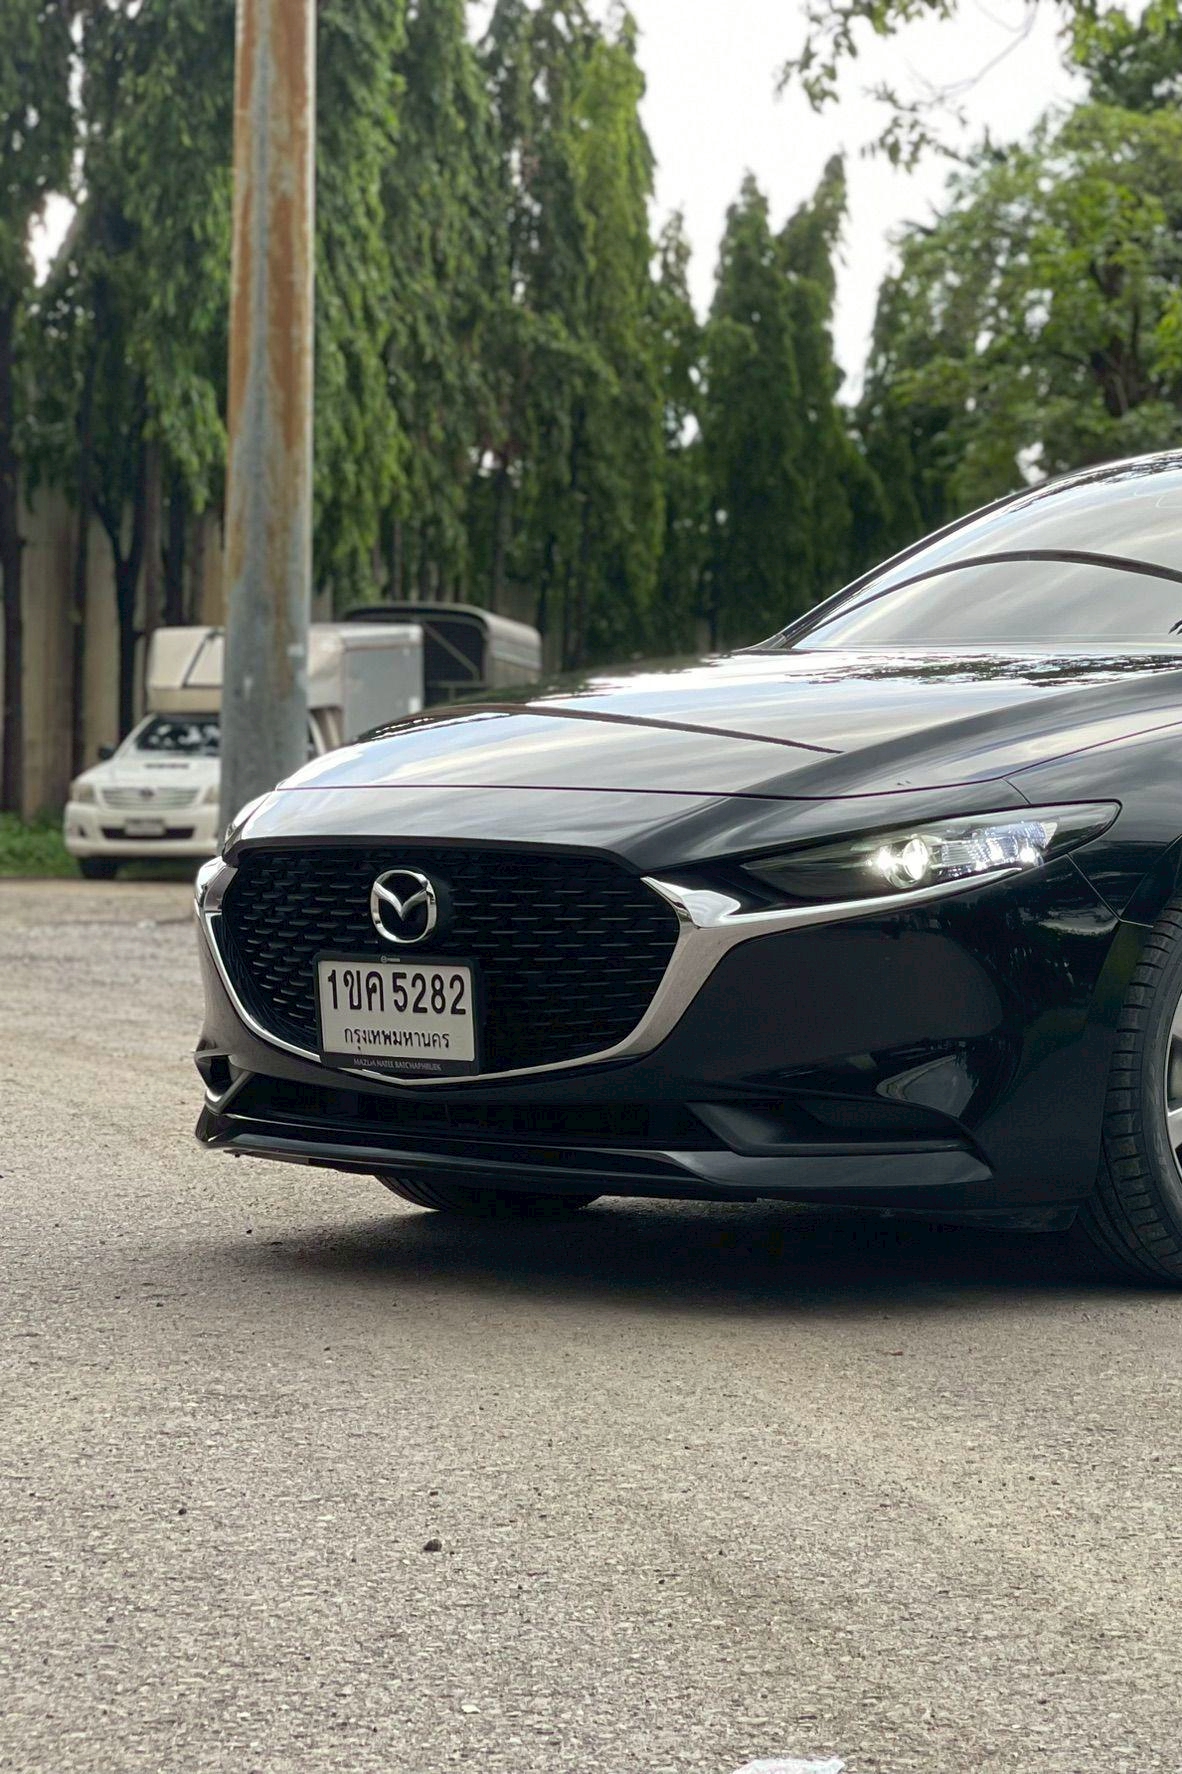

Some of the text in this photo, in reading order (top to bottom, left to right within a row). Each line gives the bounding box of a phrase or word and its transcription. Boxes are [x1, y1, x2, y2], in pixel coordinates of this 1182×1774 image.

[327, 969, 467, 1016] 1ขค 5282
[344, 1028, 450, 1051] กรุงเทพมหานคร
[353, 1058, 376, 1067] MAZDA
